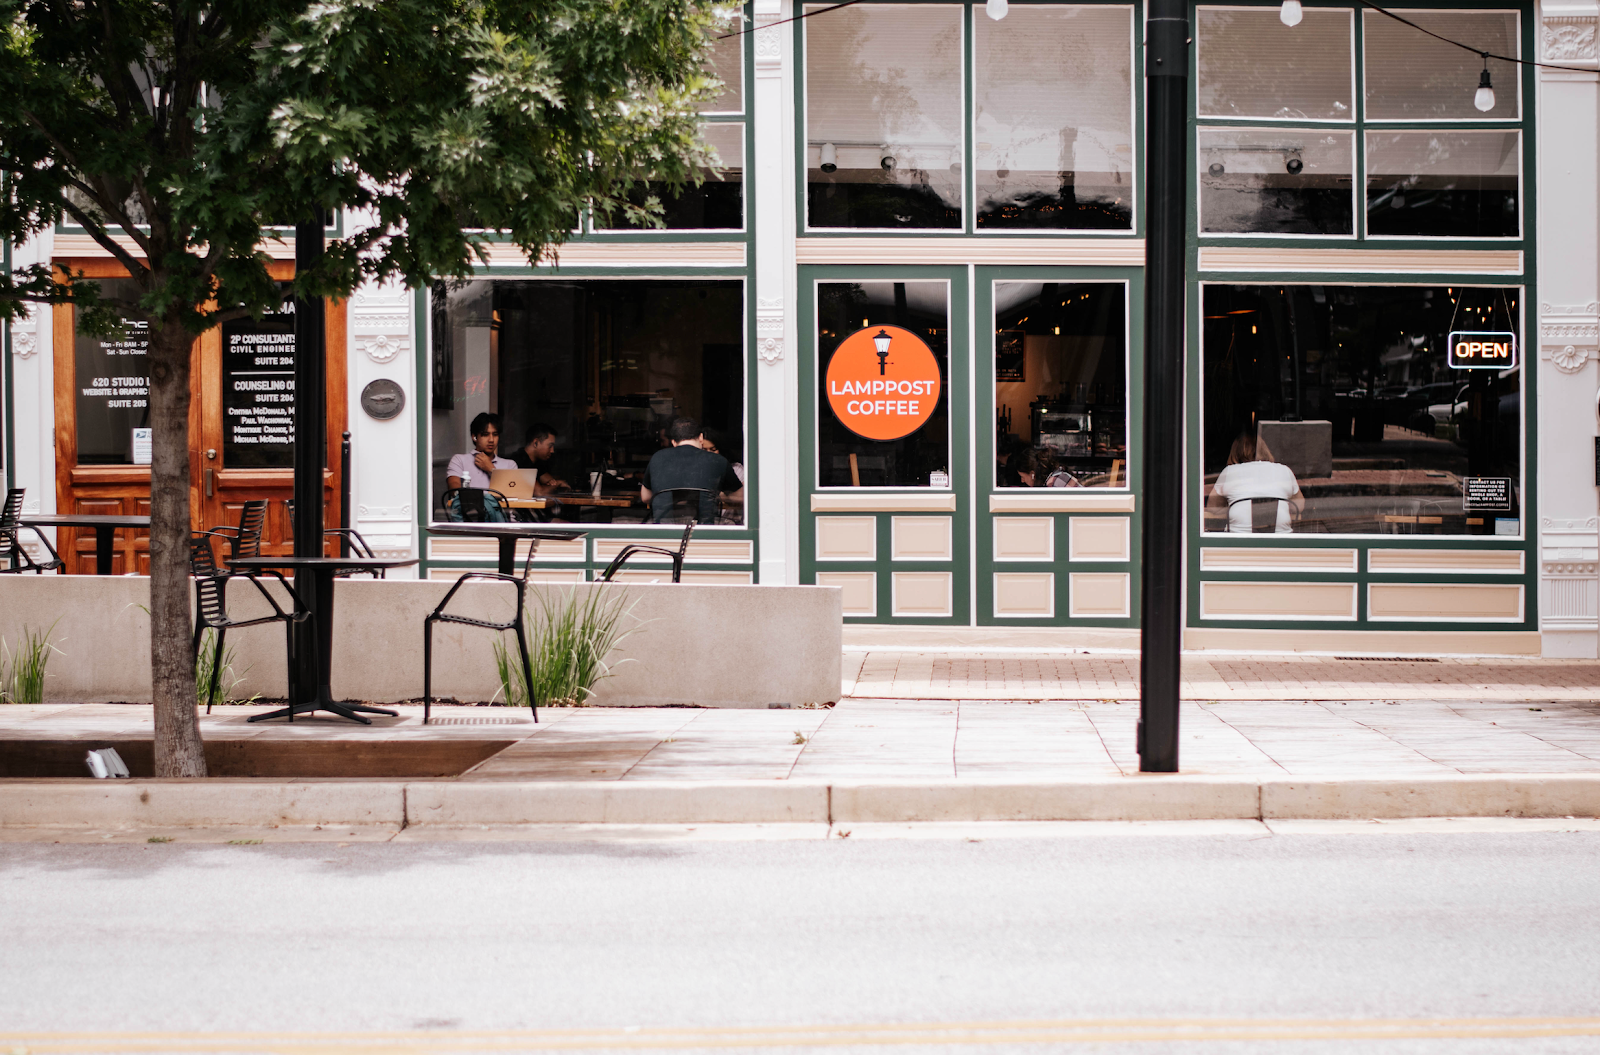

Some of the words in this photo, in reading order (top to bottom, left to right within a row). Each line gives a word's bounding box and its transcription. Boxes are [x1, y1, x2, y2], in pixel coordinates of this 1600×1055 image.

[230, 334, 242, 344] 2P
[230, 345, 254, 354] CIVIL
[256, 344, 296, 353] ENGINEE
[1455, 342, 1508, 358] OPEN
[254, 357, 278, 365] SUITE
[92, 378, 110, 386] 620
[112, 377, 144, 386] STUDIO
[234, 380, 286, 391] COUNSELING
[831, 380, 935, 396] LAMPPOST
[256, 394, 280, 402] SUITE
[280, 394, 294, 402] 206
[108, 400, 132, 408] SUITE
[132, 400, 148, 408] 205
[846, 400, 920, 416] COFFEE
